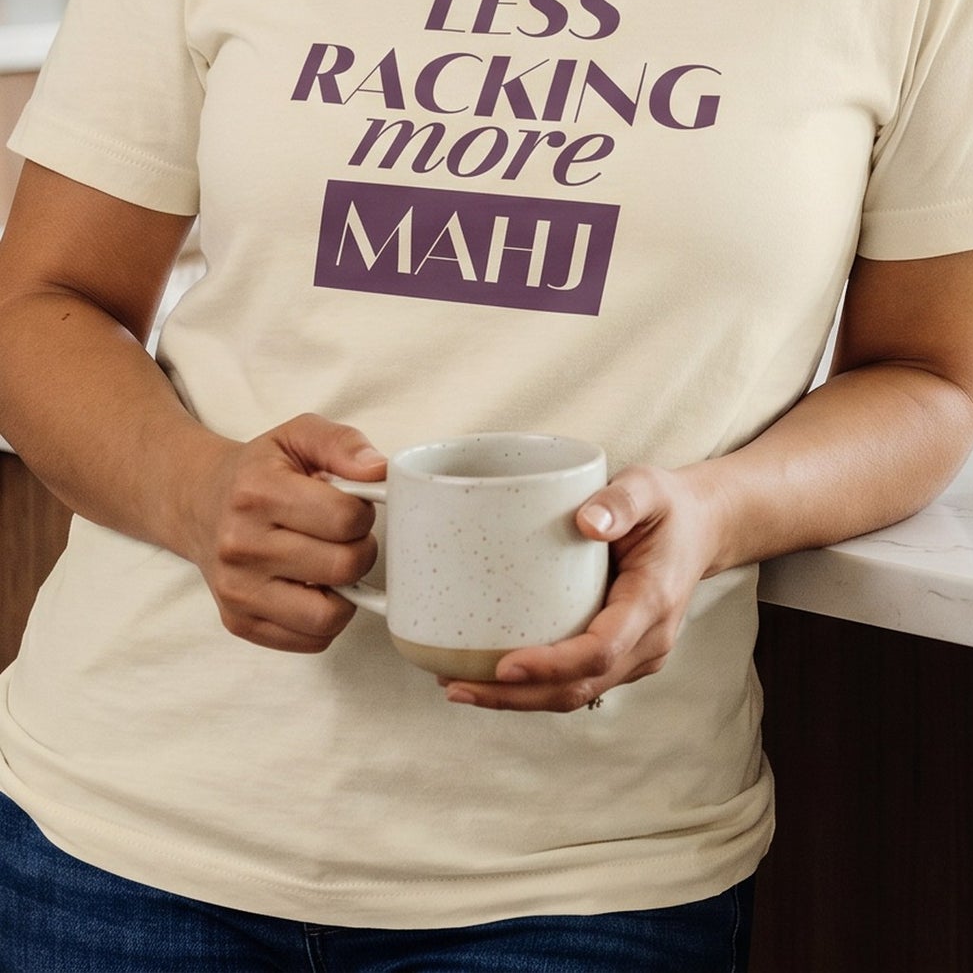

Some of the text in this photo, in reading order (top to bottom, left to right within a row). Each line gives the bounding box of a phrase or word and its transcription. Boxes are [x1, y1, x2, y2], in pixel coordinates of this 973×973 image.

[290, 43, 722, 130] RACKING
[347, 118, 615, 187] more
[335, 200, 592, 291] MAHJ
